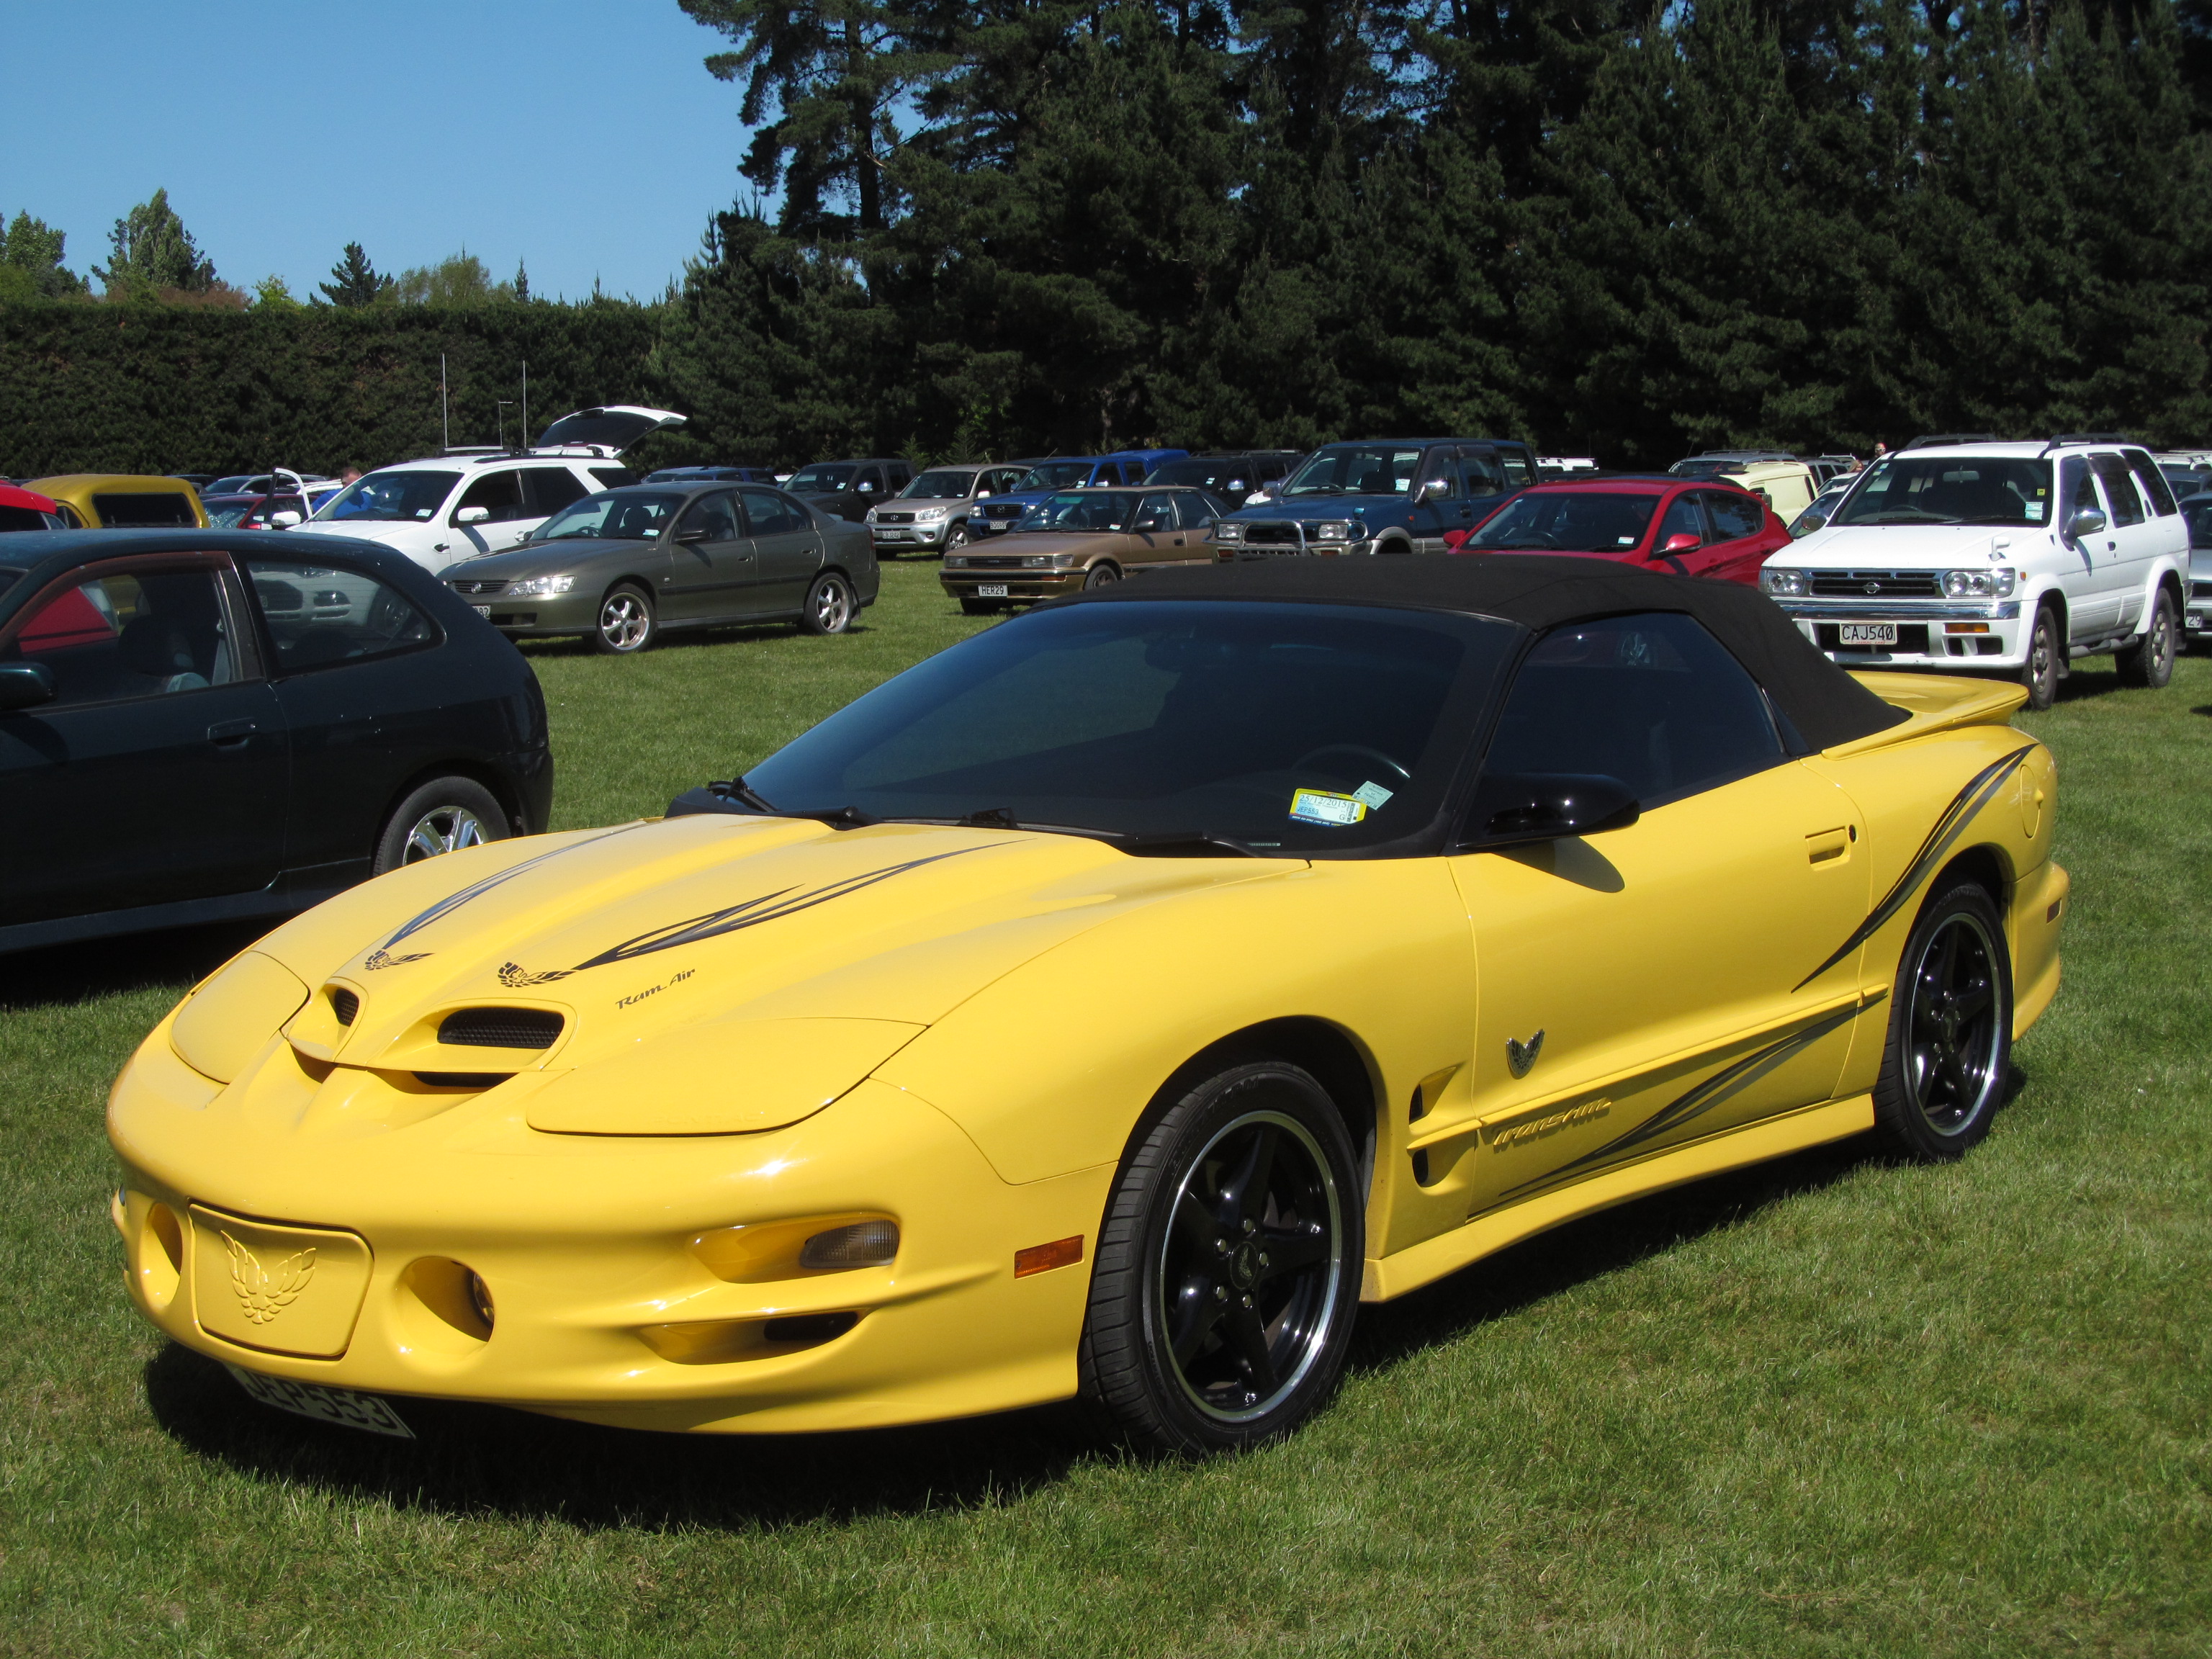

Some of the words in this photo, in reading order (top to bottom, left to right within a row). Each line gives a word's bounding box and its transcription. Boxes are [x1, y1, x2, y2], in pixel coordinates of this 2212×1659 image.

[981, 585, 1004, 595] HER29
[1842, 625, 1893, 640] CAJ540
[1299, 794, 1347, 808] 25/12/2015
[1297, 806, 1319, 815] JEP553
[615, 985, 667, 1010] Ram
[670, 968, 696, 986] Air
